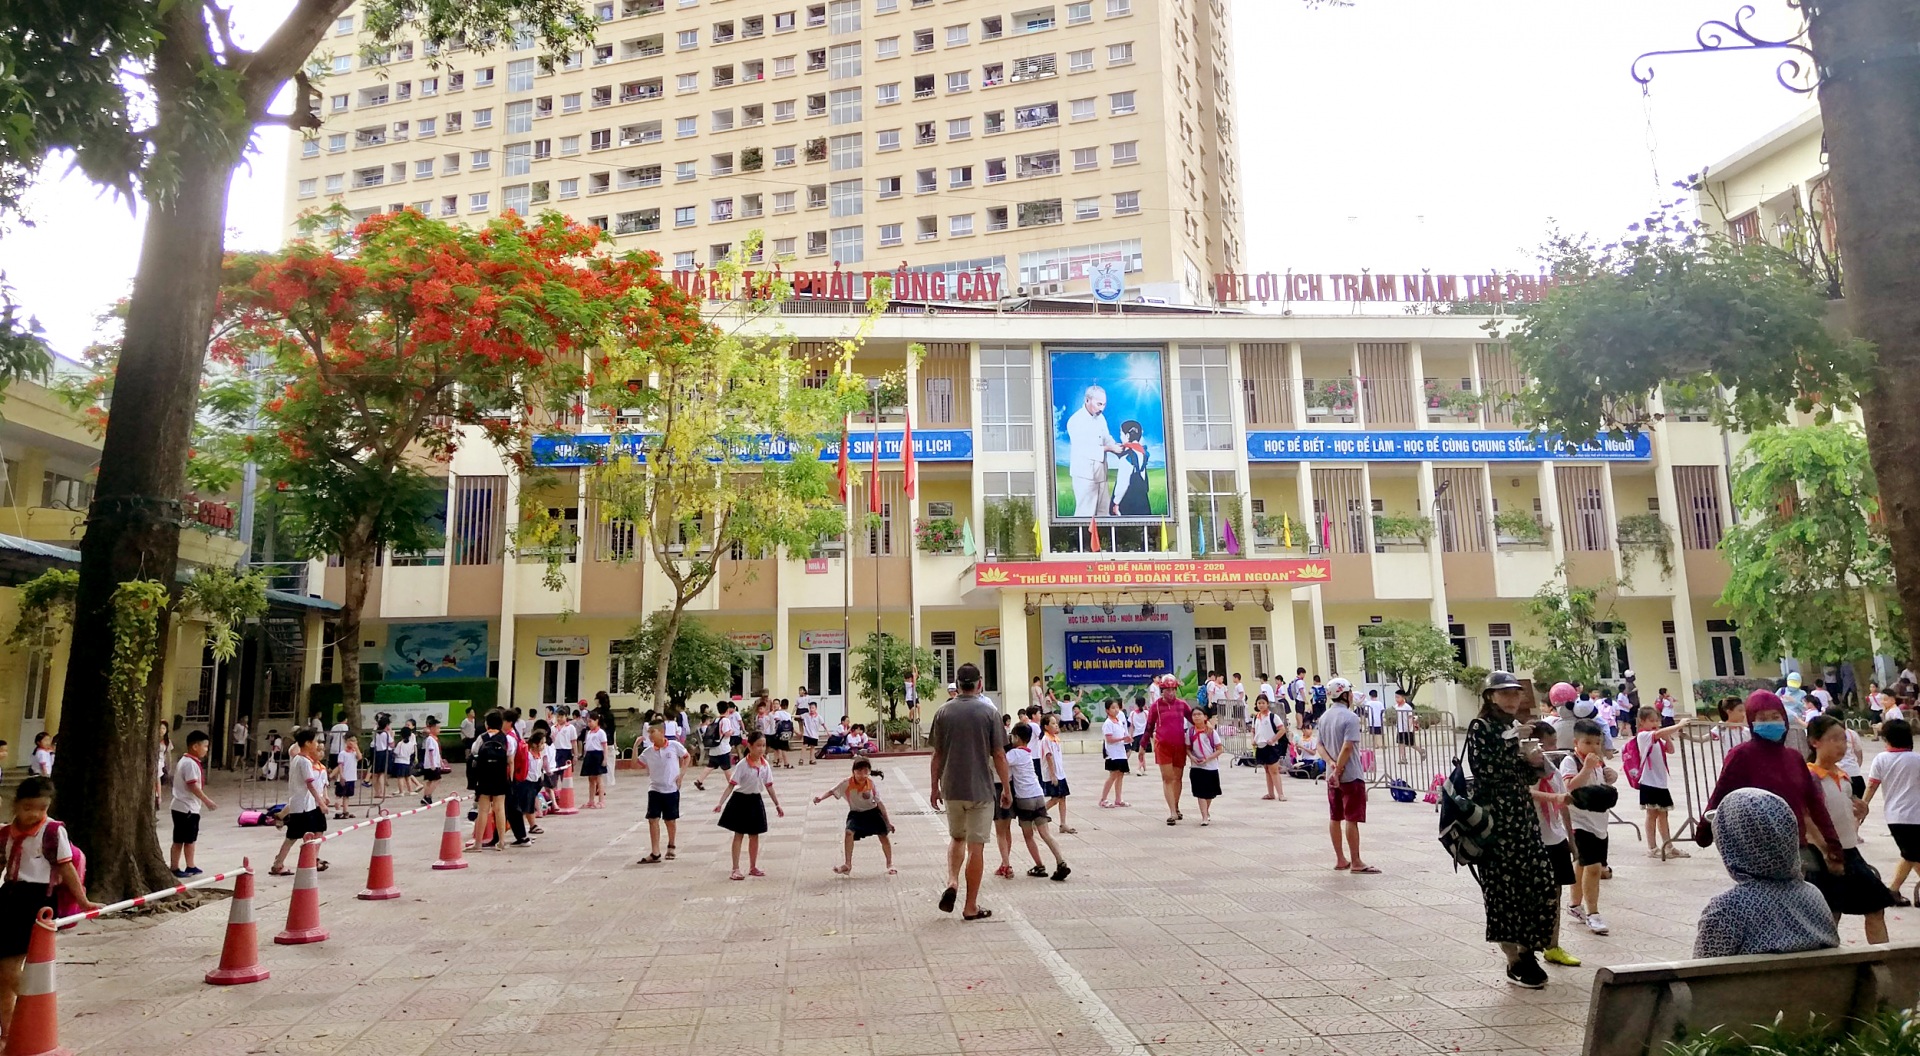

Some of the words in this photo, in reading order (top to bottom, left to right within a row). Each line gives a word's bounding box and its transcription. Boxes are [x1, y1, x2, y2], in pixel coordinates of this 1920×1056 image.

[794, 260, 853, 301] PHẢI
[957, 266, 1001, 301] CÂY
[1242, 271, 1279, 307] LỢI
[1286, 267, 1323, 301] ÍCH
[1330, 267, 1397, 301] TRĂM
[1403, 267, 1458, 302] NĂM
[926, 439, 951, 454] LỊCH
[1264, 440, 1285, 455] HỌC
[1287, 436, 1300, 452] ĐỂ
[1303, 436, 1324, 452] BIẾT
[1334, 440, 1354, 455] HỌC
[1357, 436, 1370, 452] ĐỂ
[1372, 437, 1394, 452] LÀM
[1404, 440, 1424, 455] HỌC
[1426, 436, 1439, 452] ĐỂ
[1442, 438, 1469, 452] CÙNG
[1472, 440, 1506, 452] CHUNG
[1098, 563, 1115, 571] CHỦ
[1118, 563, 1129, 571] ĐỀ
[1131, 563, 1151, 571] NĂM
[1154, 564, 1171, 573] HỌC
[1060, 575, 1082, 583] NHI
[1086, 573, 1110, 583] THỦ
[1114, 573, 1132, 583] ĐÔ
[1135, 573, 1171, 583] ĐOÀN
[1174, 571, 1200, 583] KẾT,
[1203, 572, 1241, 582] CHĂM
[1097, 645, 1122, 654] NGÀY
[1124, 644, 1143, 655] HỘI
